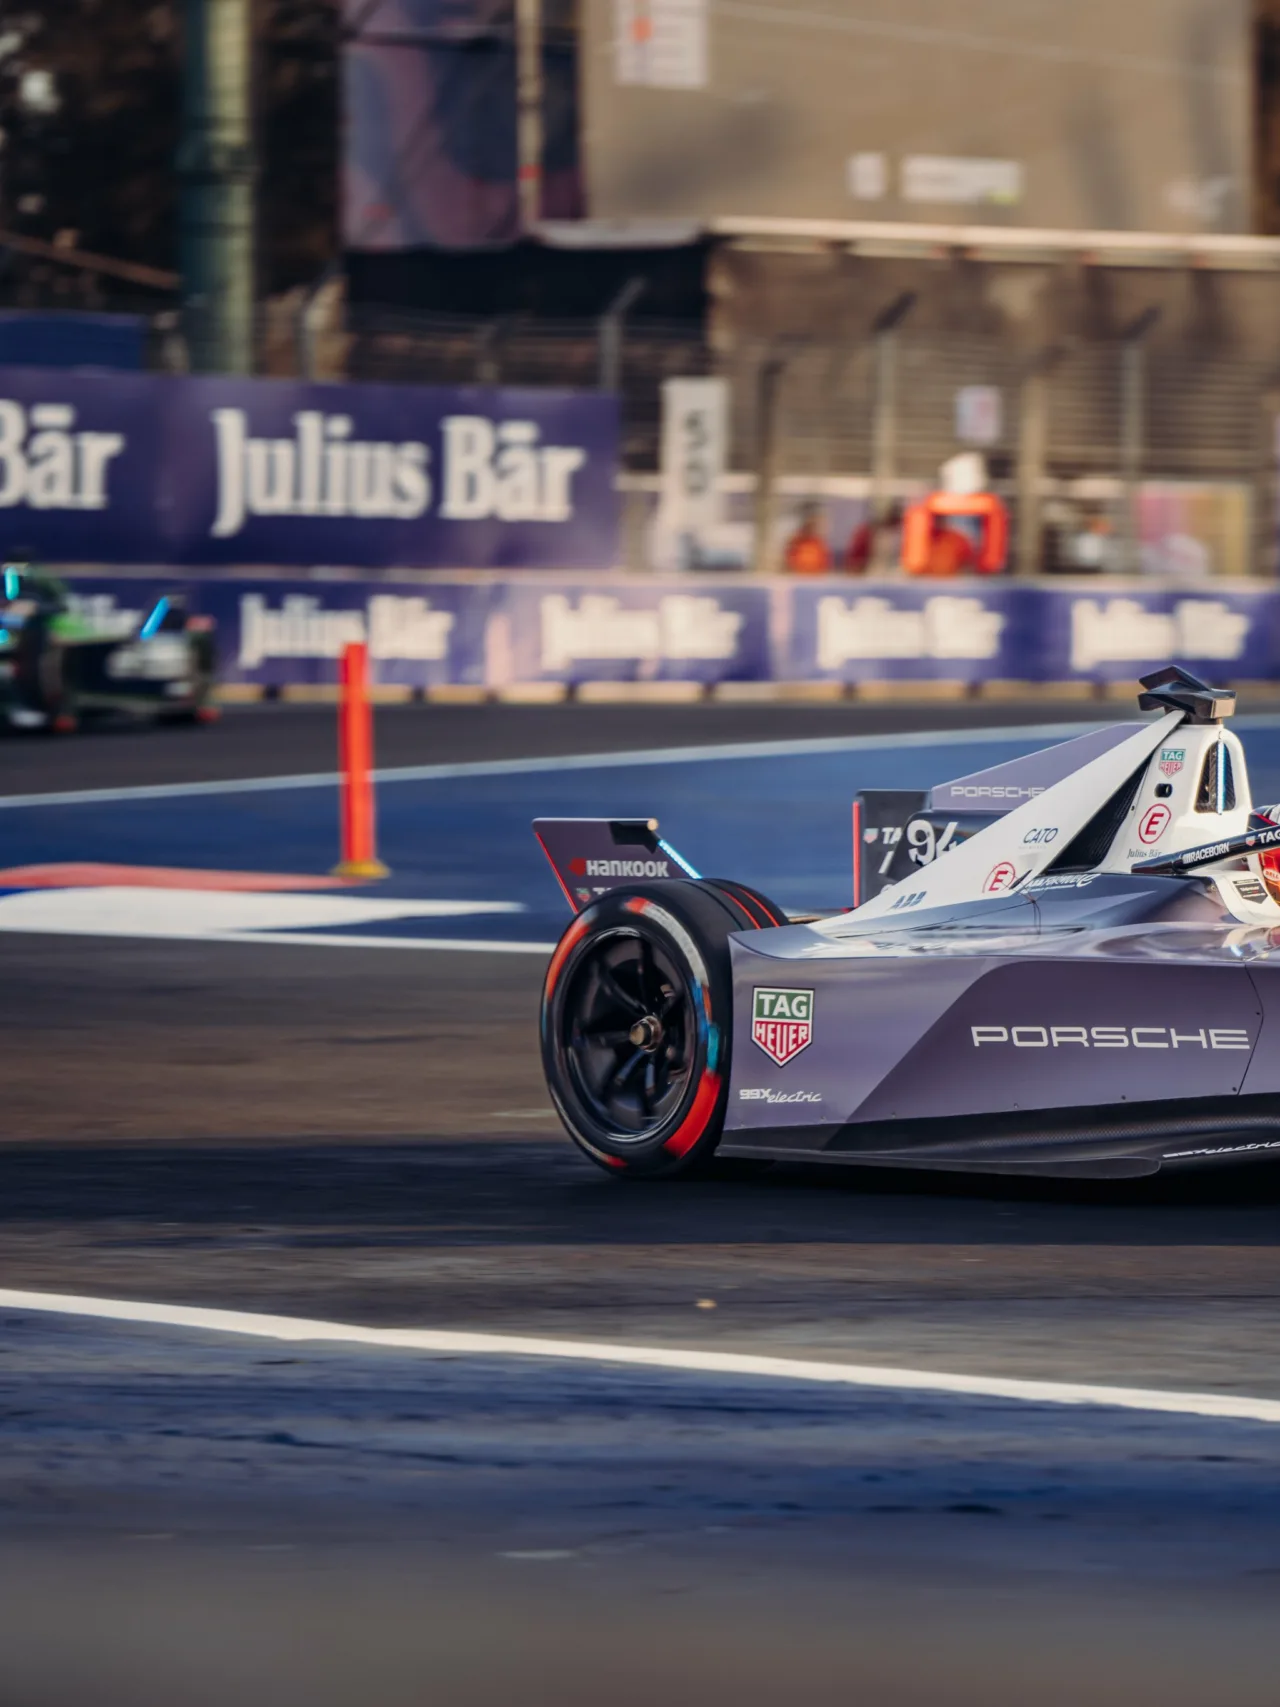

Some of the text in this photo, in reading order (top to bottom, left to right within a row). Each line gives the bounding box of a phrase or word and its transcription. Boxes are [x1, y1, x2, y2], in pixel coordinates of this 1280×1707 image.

[212, 409, 430, 536] Julius
[1163, 750, 1183, 760] TAG
[950, 786, 1046, 799] PORSCHE
[1145, 813, 1164, 835] E
[1023, 828, 1059, 844] CATO
[1190, 843, 1230, 863] RACEBORN
[759, 994, 808, 1018] TAG
[755, 1023, 808, 1059] HEUER
[970, 1026, 1250, 1050] PORSCHE
